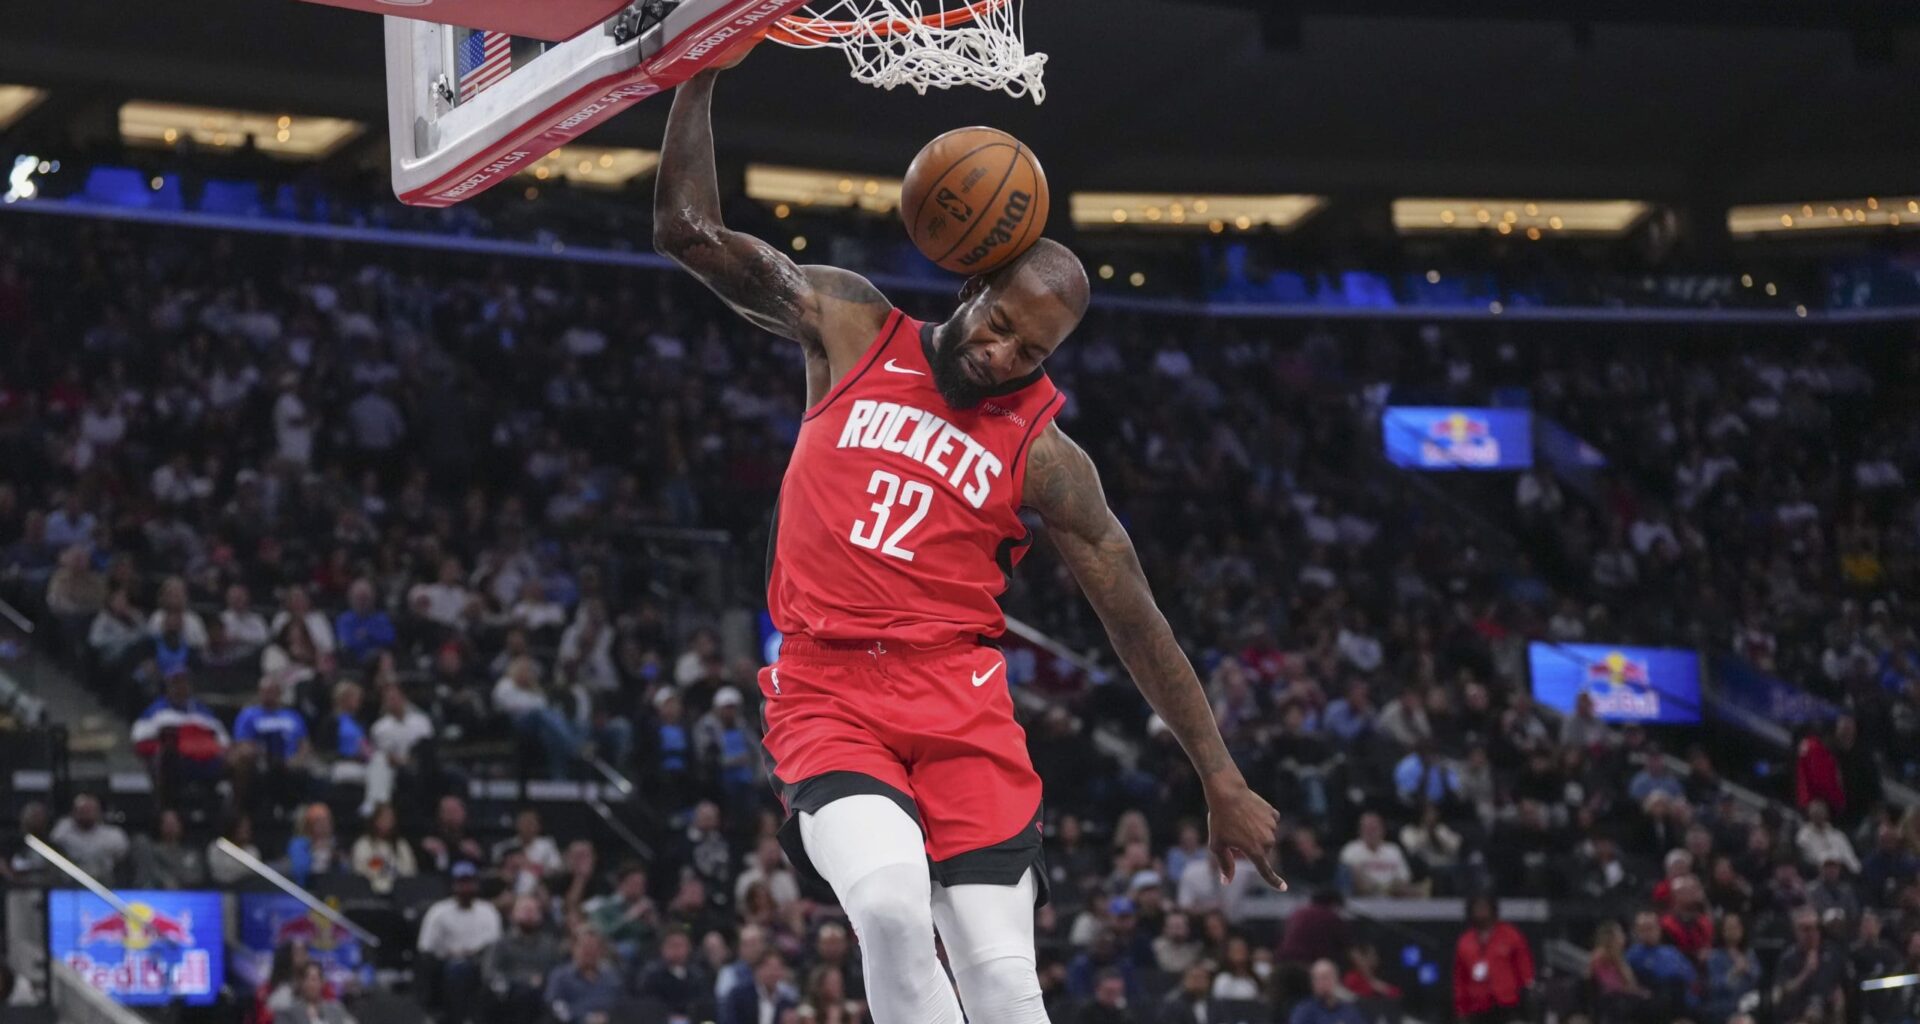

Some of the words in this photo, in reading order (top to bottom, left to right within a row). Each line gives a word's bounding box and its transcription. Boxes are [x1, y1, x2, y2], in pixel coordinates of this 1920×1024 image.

[682, 26, 742, 60] HERDEZ
[735, 0, 791, 26] SALSA
[553, 103, 608, 130] HERDEZ
[600, 82, 648, 103] SALSA
[440, 173, 492, 198] HERDEZ
[484, 151, 531, 174] SALSA
[957, 189, 1032, 267] Wilson
[836, 399, 1003, 510] ROCKETS
[849, 469, 934, 562] 32
